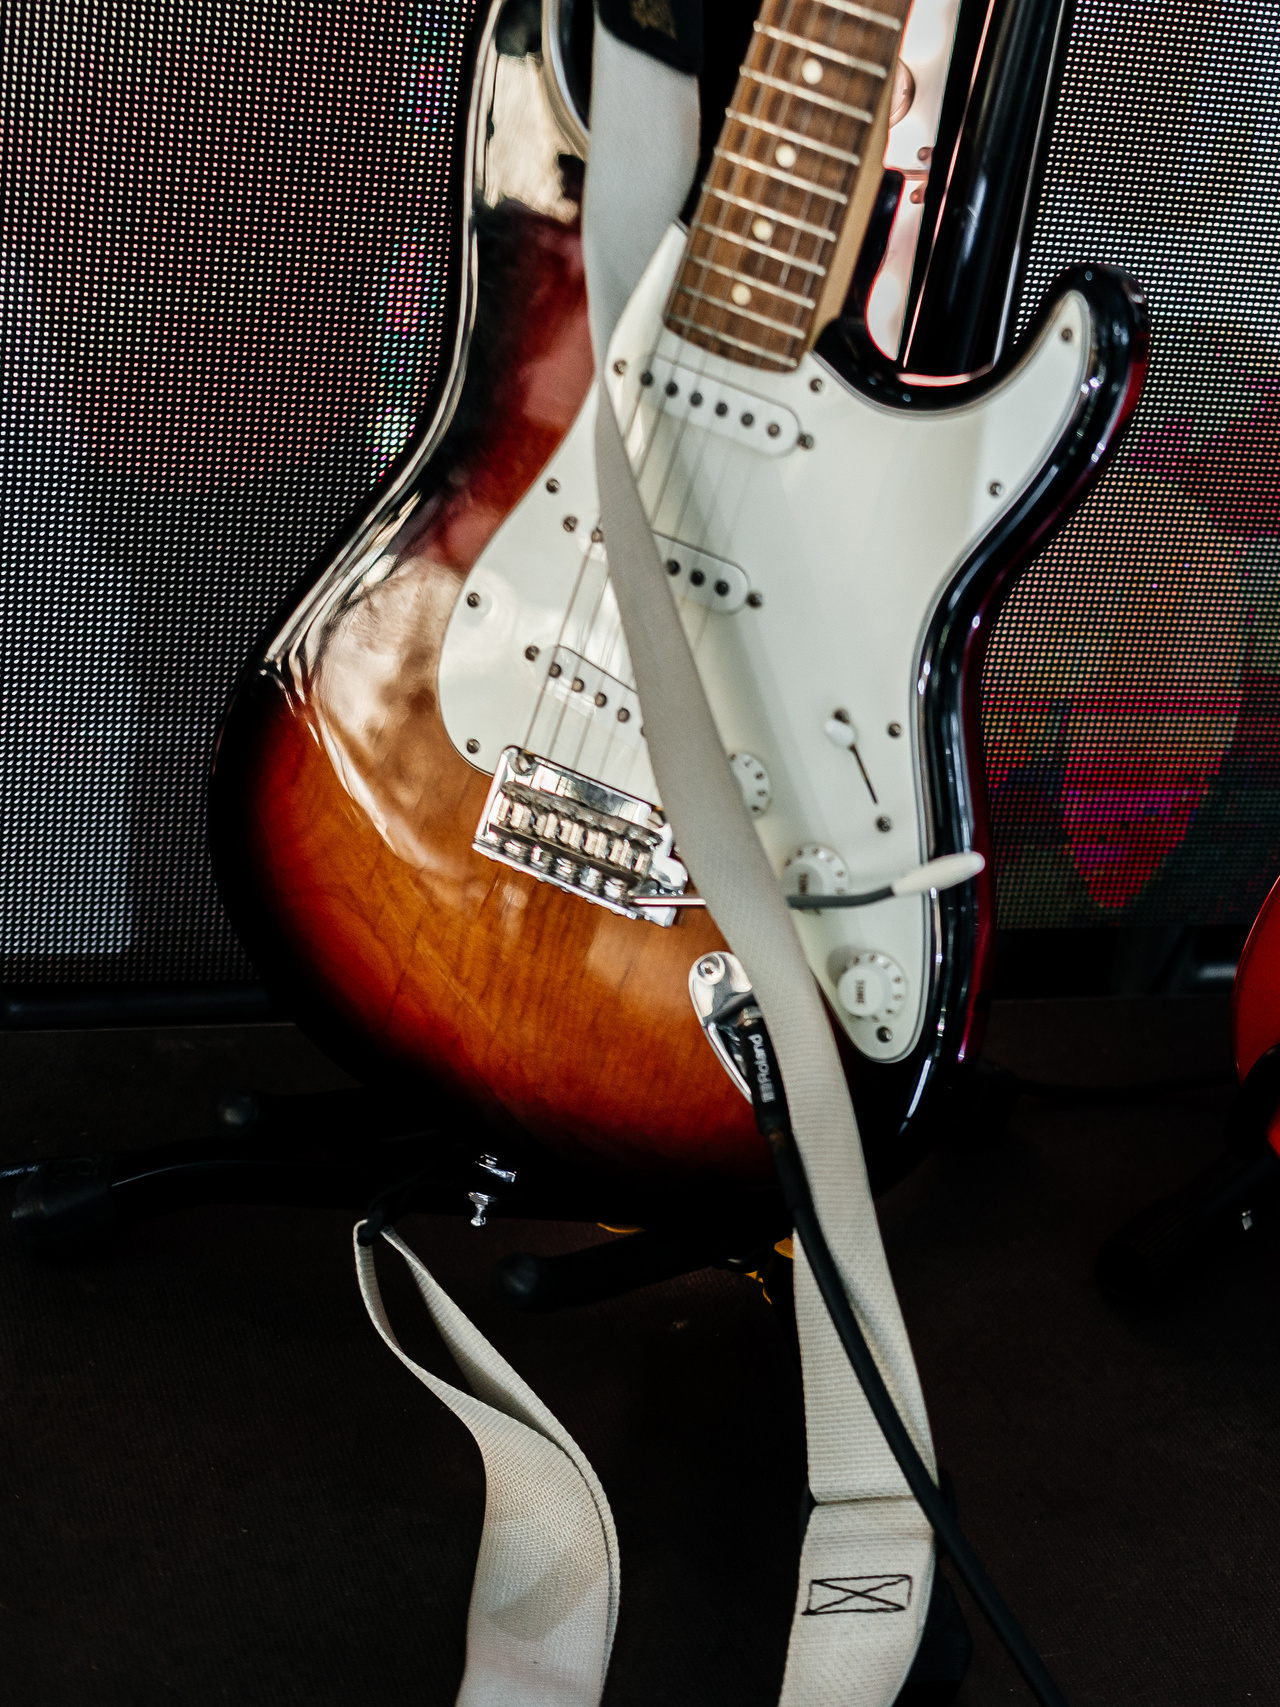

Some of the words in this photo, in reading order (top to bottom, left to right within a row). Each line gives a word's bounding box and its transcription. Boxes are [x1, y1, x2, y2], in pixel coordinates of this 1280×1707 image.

[798, 872, 809, 896] TON
[856, 980, 865, 1003] TONE
[748, 1033, 771, 1083] Roland
